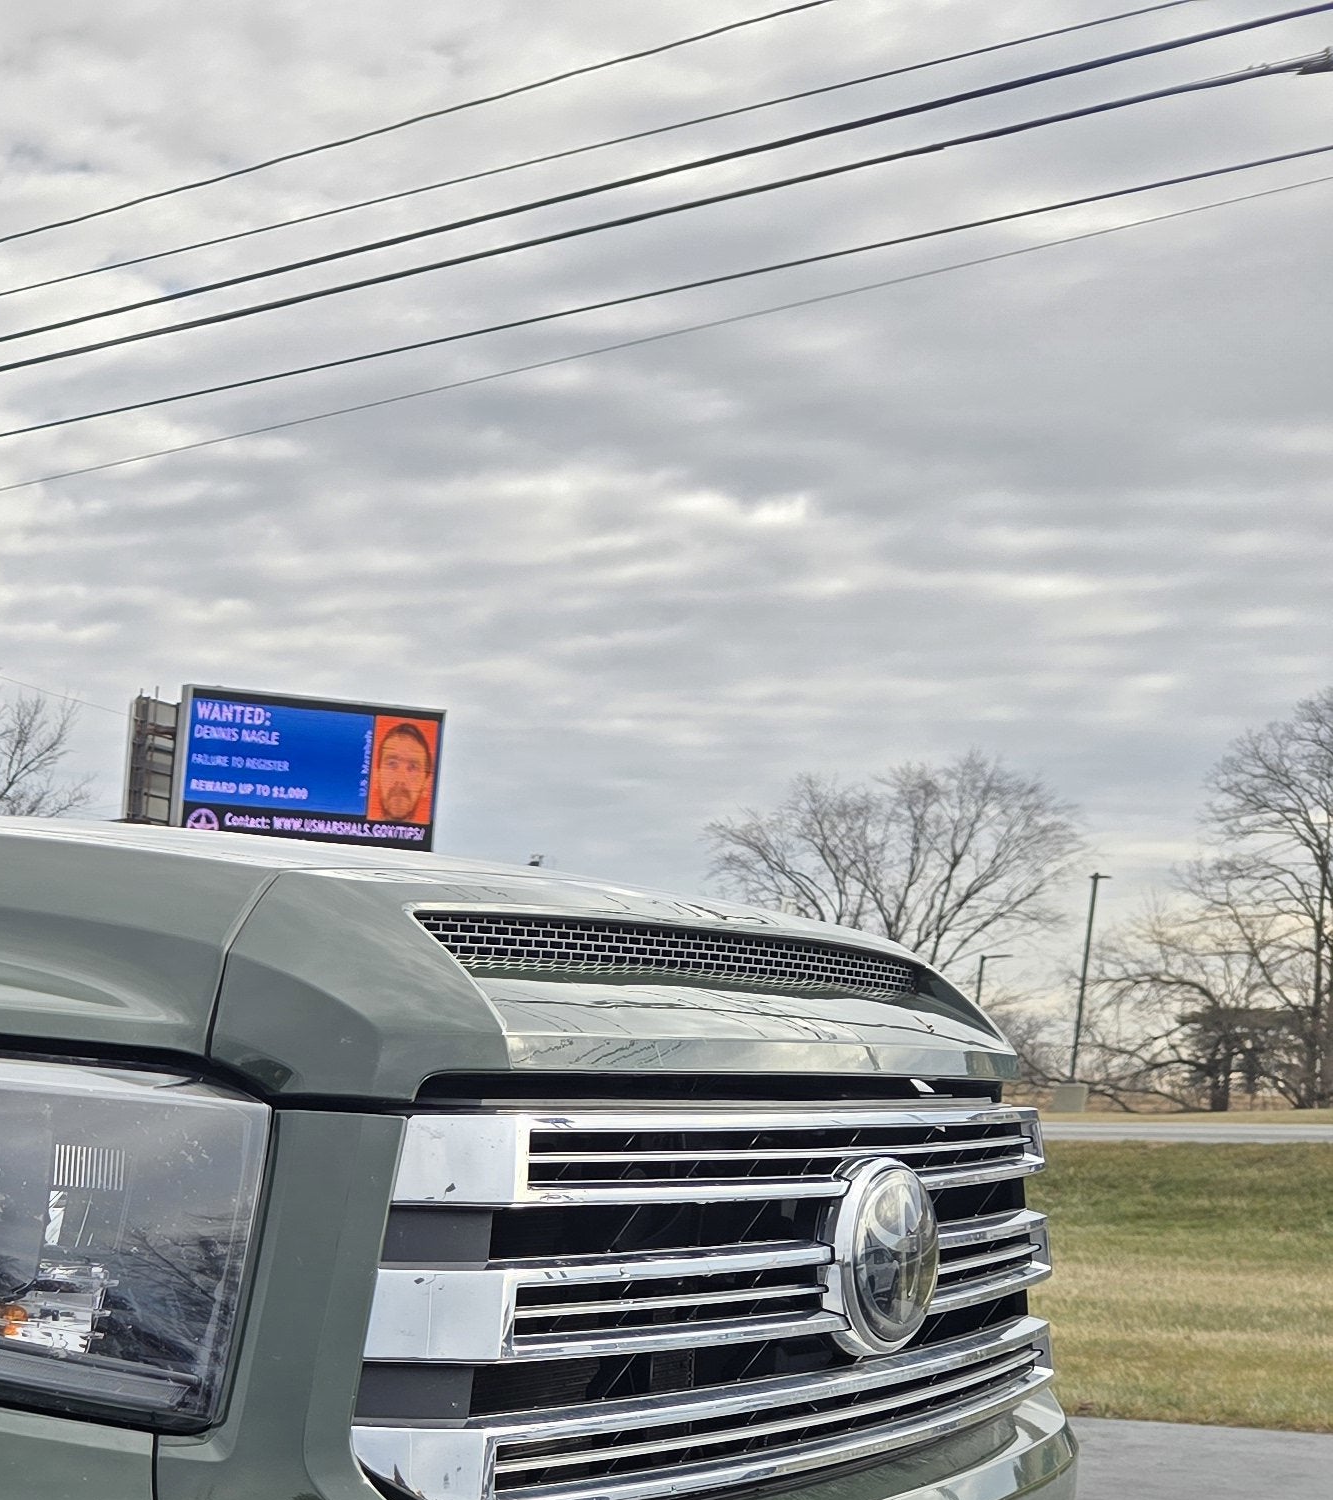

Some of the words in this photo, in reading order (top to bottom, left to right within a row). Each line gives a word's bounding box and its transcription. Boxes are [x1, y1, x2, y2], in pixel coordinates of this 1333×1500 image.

[197, 701, 271, 726] WANTED:
[190, 779, 237, 793] REWARD
[239, 783, 254, 794] UP
[256, 784, 270, 796] TO
[224, 813, 270, 829] Contact:
